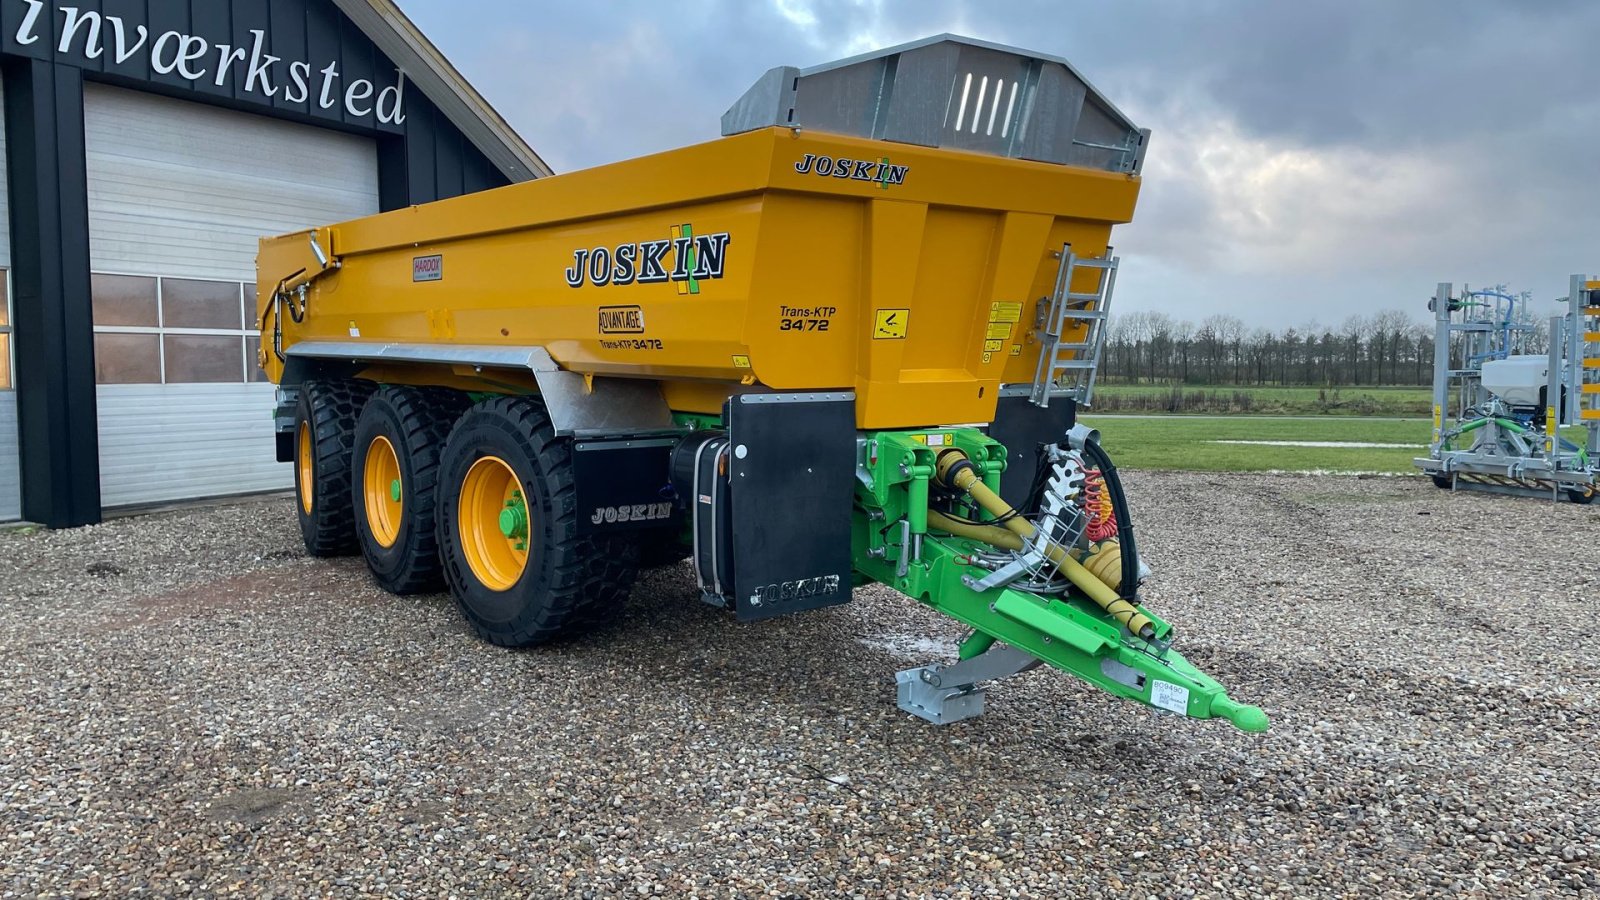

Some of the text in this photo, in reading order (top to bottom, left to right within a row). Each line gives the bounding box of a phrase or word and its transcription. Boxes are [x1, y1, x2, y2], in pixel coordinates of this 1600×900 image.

[794, 153, 909, 186] JOSKIN
[414, 257, 441, 272] HARDOX
[565, 232, 731, 288] JOSKIN
[780, 305, 836, 317] Trans-KTP
[599, 310, 641, 334] ADVANTAGE
[780, 318, 830, 331] 34/72
[599, 339, 632, 349] Trans-KTP
[591, 502, 673, 525] JOSKIN
